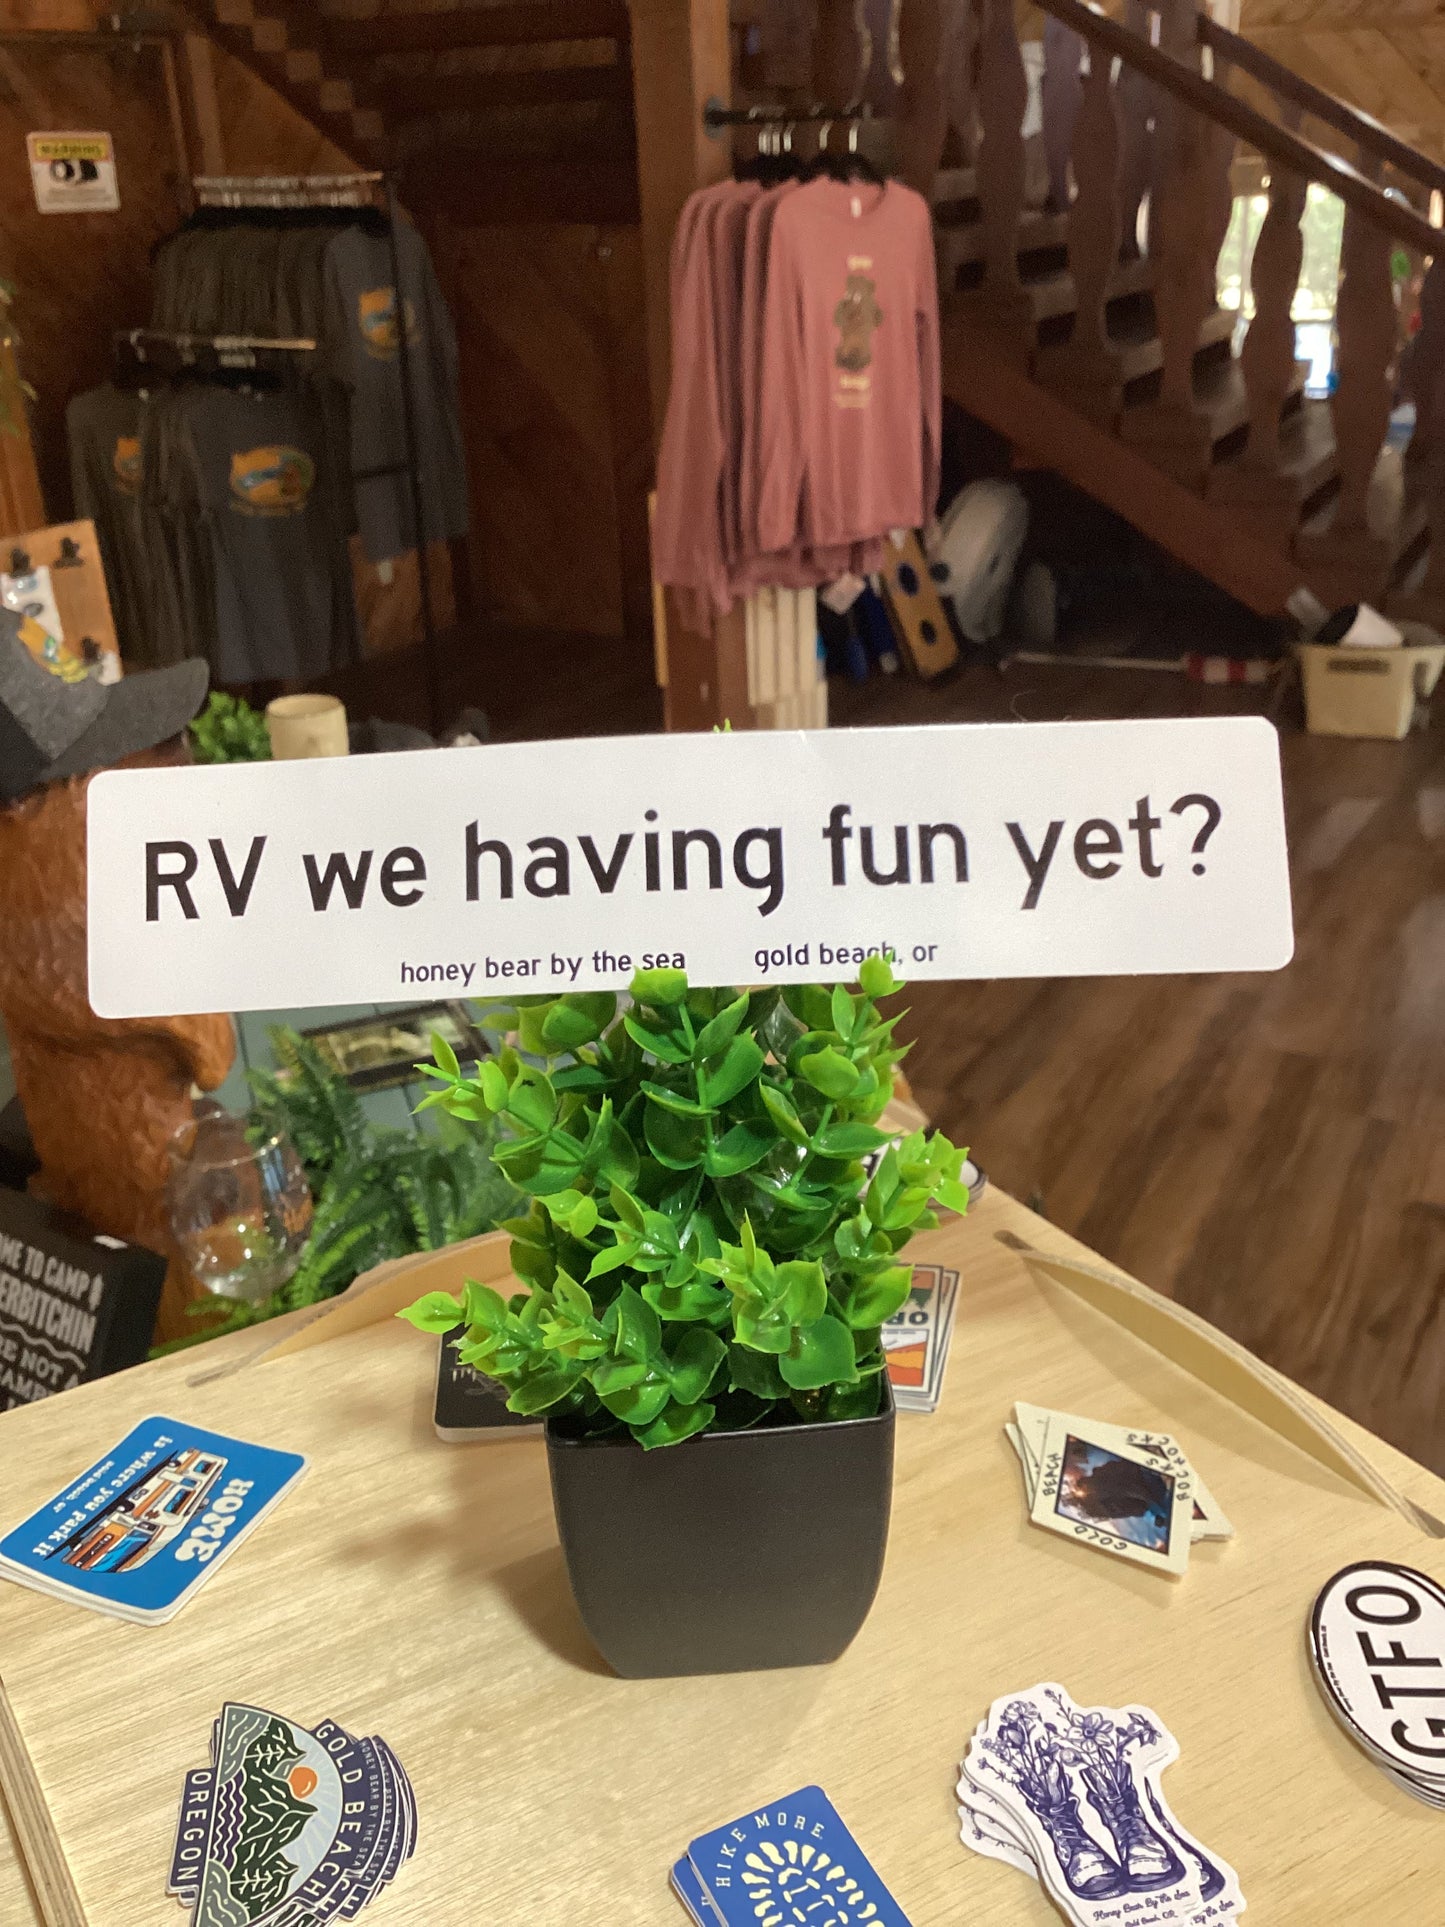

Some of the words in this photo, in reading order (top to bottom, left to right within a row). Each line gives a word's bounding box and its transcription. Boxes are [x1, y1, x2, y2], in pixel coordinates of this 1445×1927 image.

[144, 835, 268, 922] RV
[302, 843, 427, 912] we
[465, 809, 785, 917] having
[822, 804, 969, 886] fun
[1006, 793, 1222, 910] yet?
[401, 961, 477, 987] honey
[485, 956, 542, 978] bear
[551, 952, 583, 981] by
[592, 950, 632, 973] the
[642, 952, 686, 971] sea
[754, 943, 809, 974] gold
[912, 945, 938, 962] or
[25, 1246, 45, 1280] TO
[44, 1256, 91, 1300] CAMP
[20, 1348, 64, 1386] NOT
[111, 1451, 157, 1488] where
[1042, 1453, 1062, 1496] BEACH
[1146, 1458, 1191, 1501] ROCKS
[84, 1487, 114, 1512] you
[48, 1510, 87, 1542] park
[175, 1479, 254, 1562] HOME
[1074, 1525, 1128, 1551] GOLD
[32, 1542, 55, 1556] it
[1345, 1585, 1445, 1758] GTFO
[316, 1723, 363, 1784] GOLD
[369, 1775, 380, 1800] BEAR
[177, 1771, 212, 1881] OREGON
[369, 1804, 380, 1818] BY
[303, 1800, 365, 1897] BEACH
[363, 1823, 376, 1842] THE
[375, 1838, 389, 1858] THE
[352, 1847, 368, 1868] SEA
[363, 1862, 379, 1882] SEA
[715, 1827, 747, 1887] HIKE
